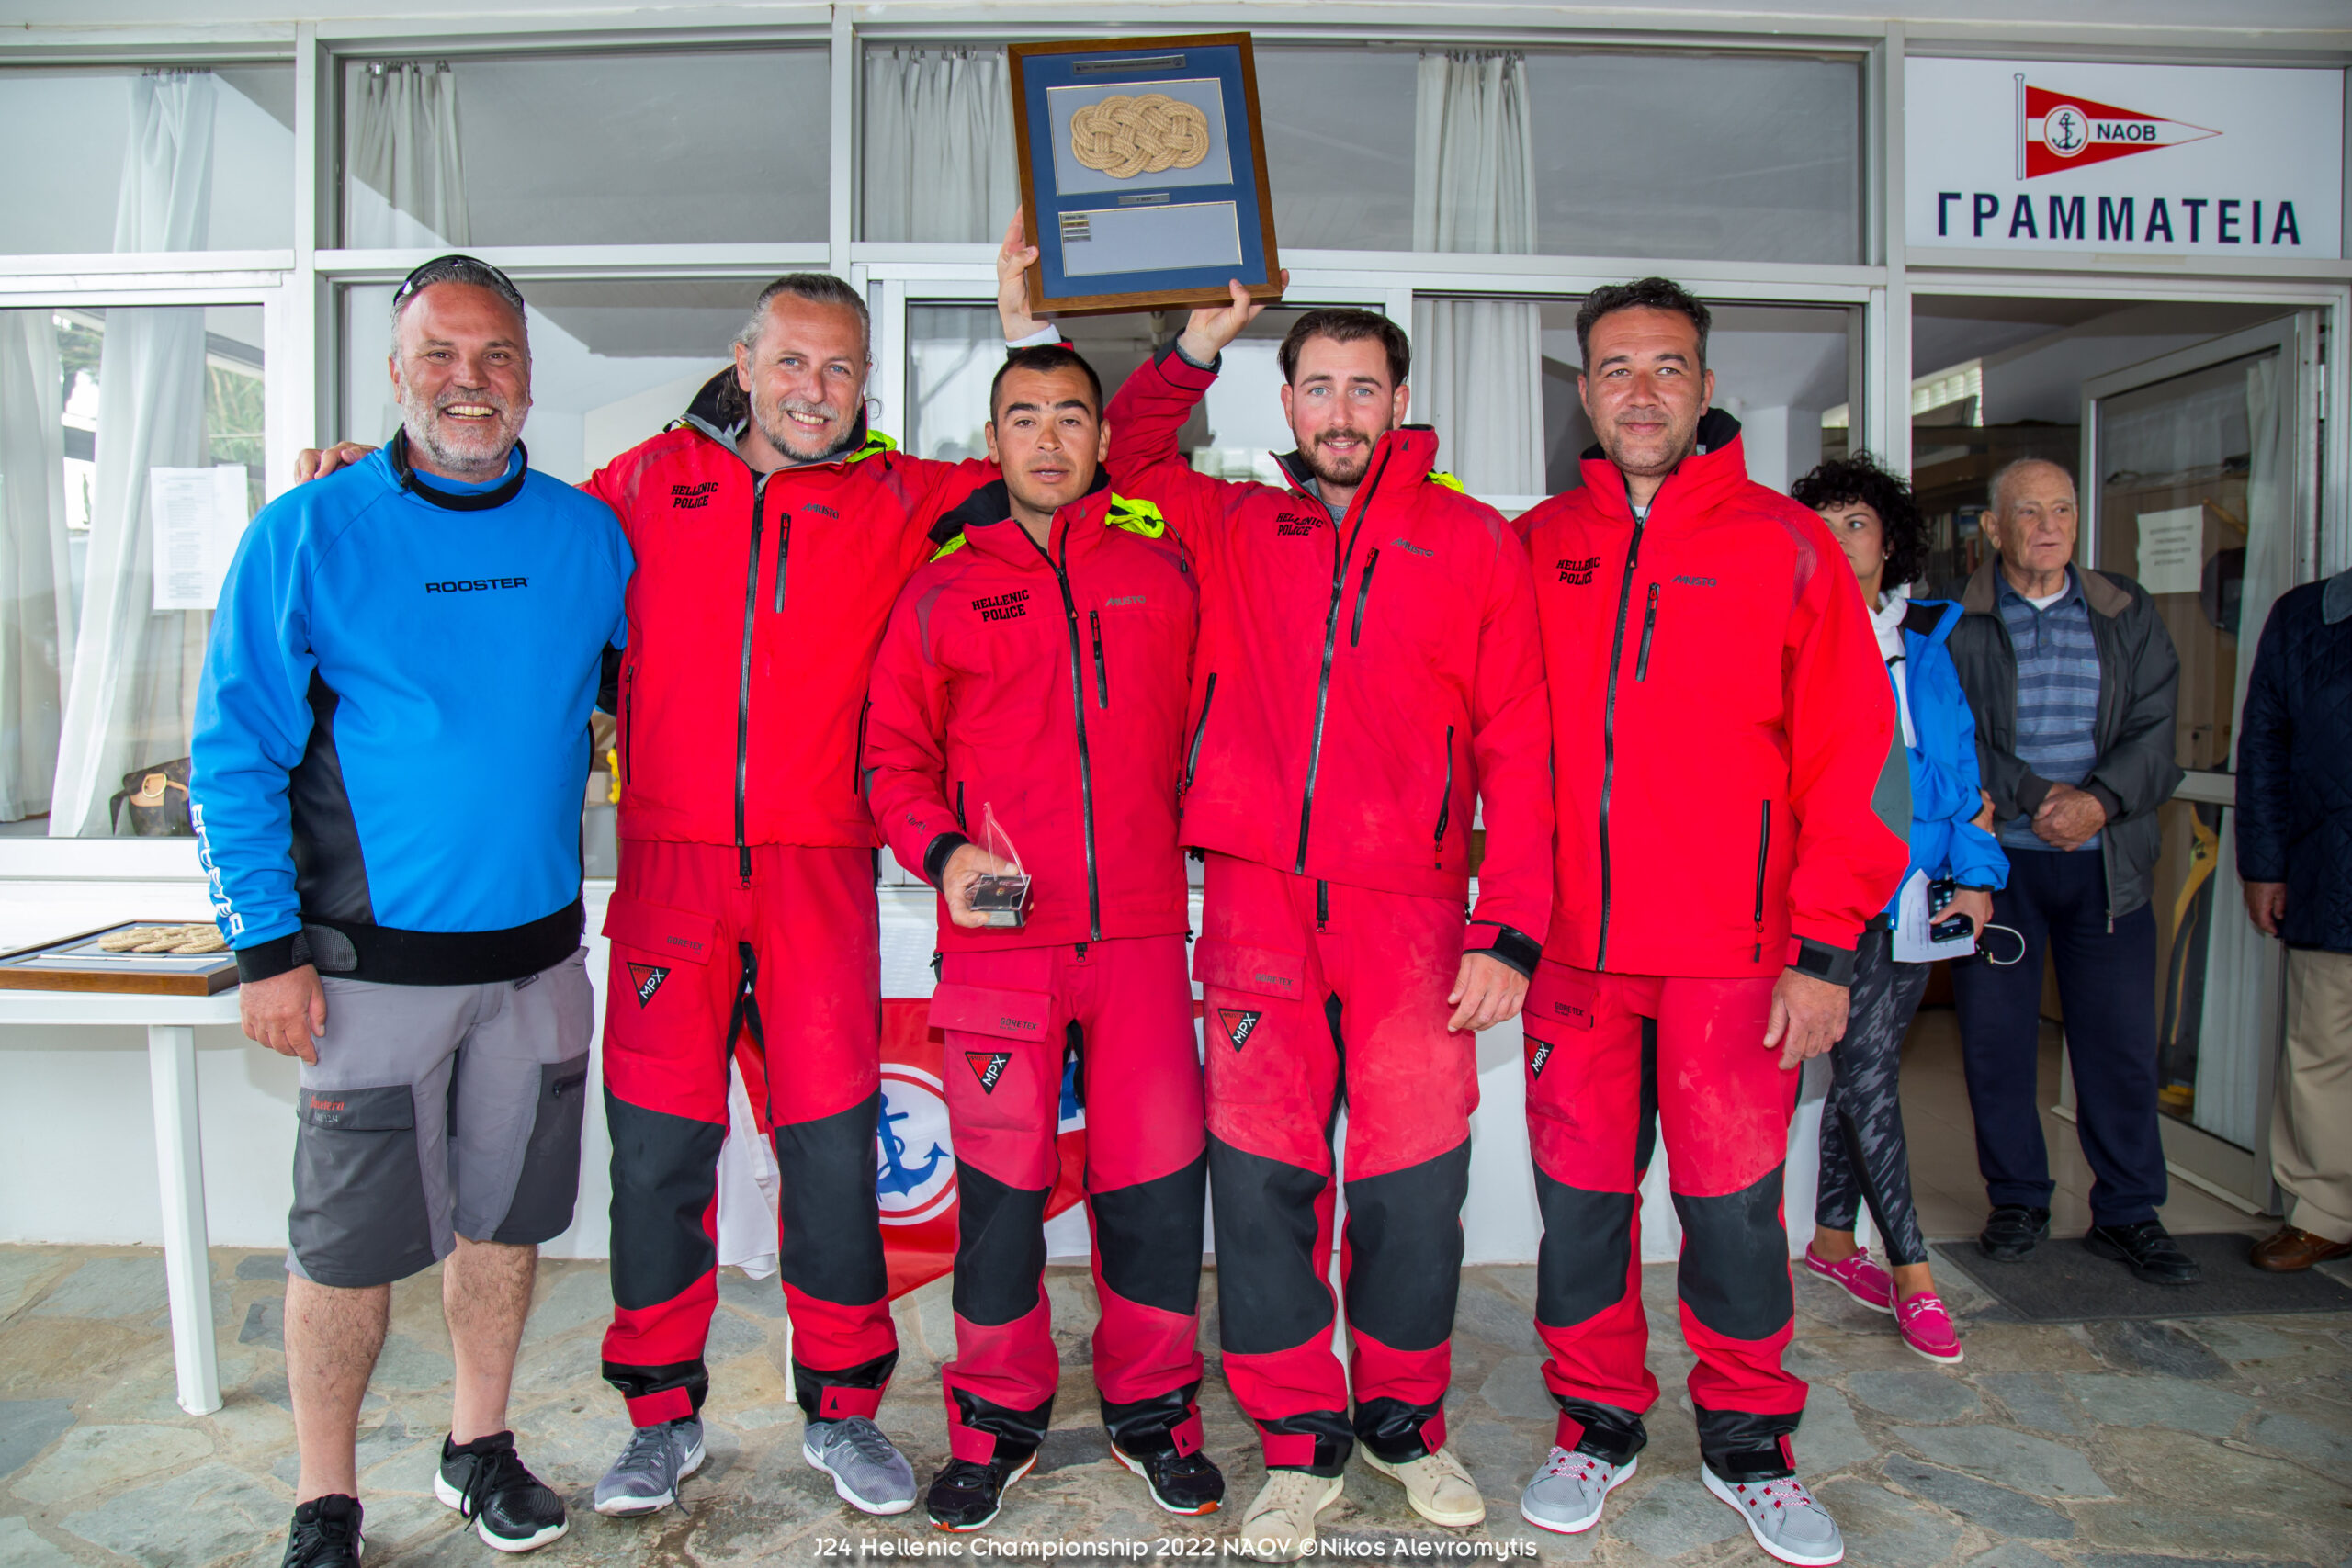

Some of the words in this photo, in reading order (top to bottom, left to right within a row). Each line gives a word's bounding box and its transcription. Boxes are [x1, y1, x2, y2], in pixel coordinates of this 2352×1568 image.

[1937, 191, 2301, 246] ΓΡΑΜΜΑΤΕΙΑ
[673, 495, 709, 509] POLICE
[424, 577, 528, 593] ROOSTER
[1670, 574, 1718, 588] MUSTO
[971, 589, 1030, 611] HELLENIC
[981, 604, 1026, 623] POLICE
[639, 968, 665, 999] MPX
[1232, 1012, 1257, 1044] MPX
[981, 1055, 1007, 1087] MPX
[1531, 1043, 1550, 1073] MPX
